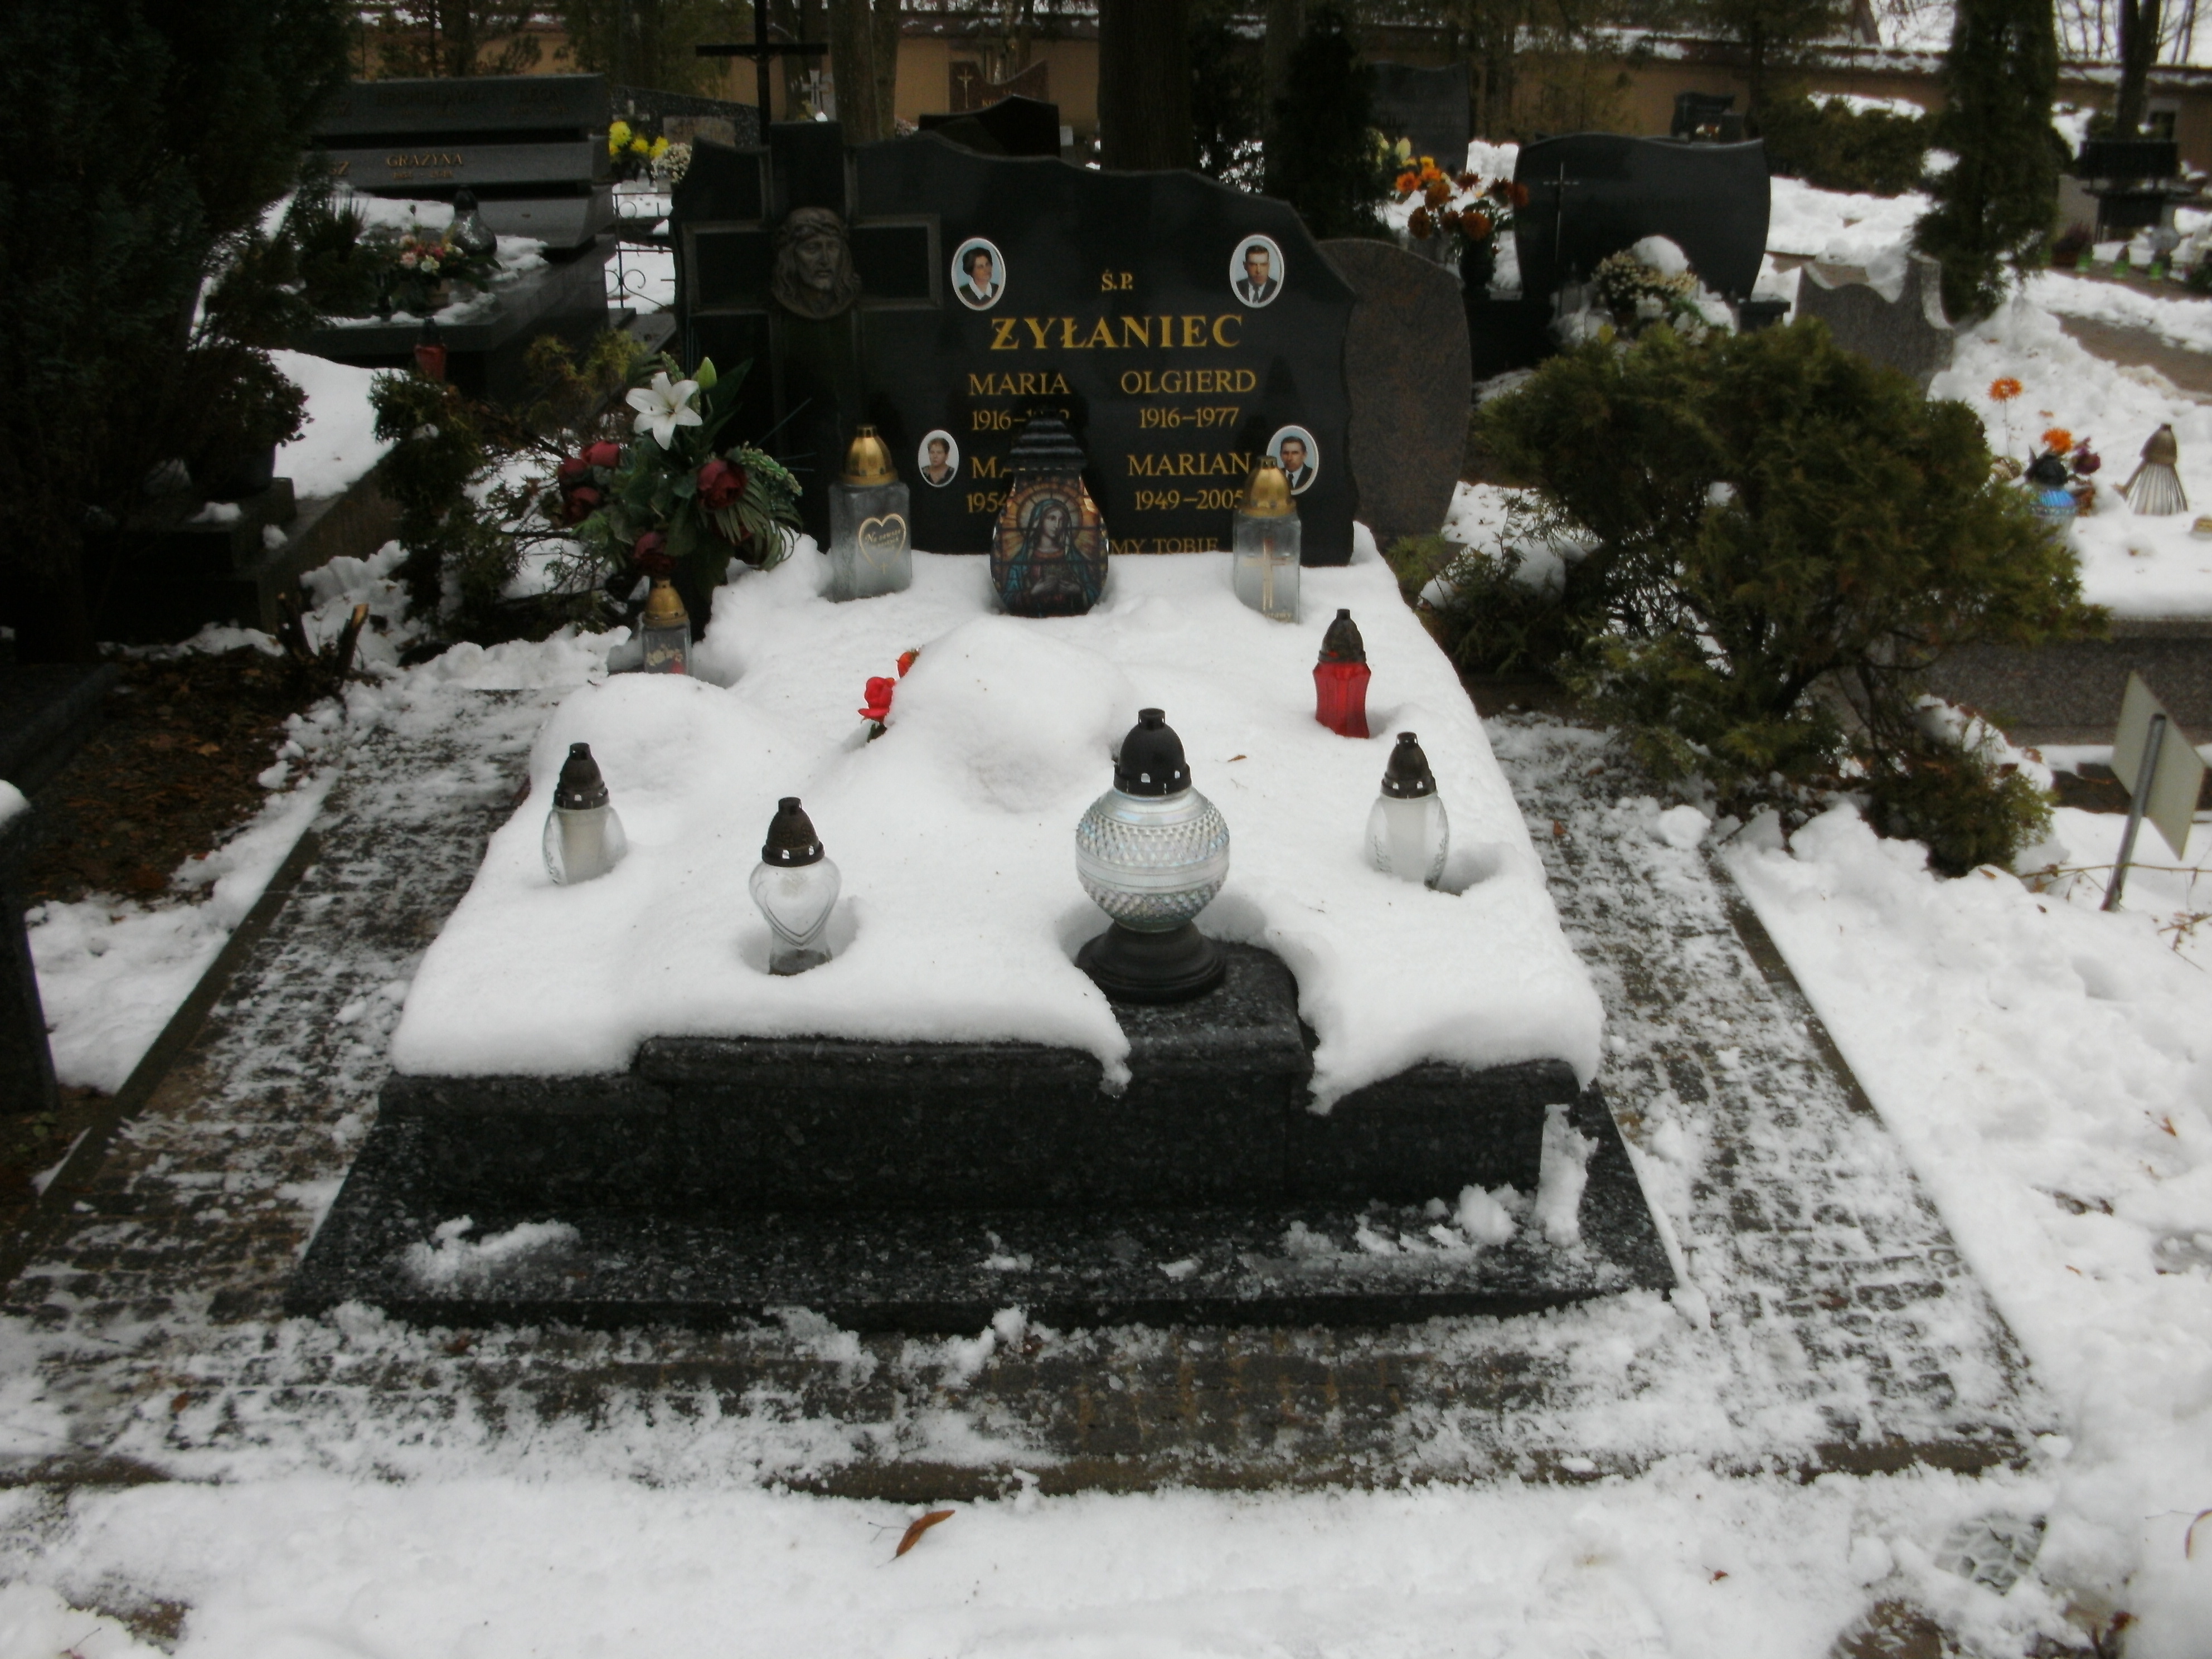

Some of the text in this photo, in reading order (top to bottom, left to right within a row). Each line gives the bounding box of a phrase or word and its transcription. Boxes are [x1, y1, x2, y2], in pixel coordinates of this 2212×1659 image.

[385, 151, 464, 168] GRAŻYNA
[969, 372, 1071, 396] MARIA
[1120, 368, 1257, 394] OLGIERD
[1127, 452, 1253, 477] MARIAN
